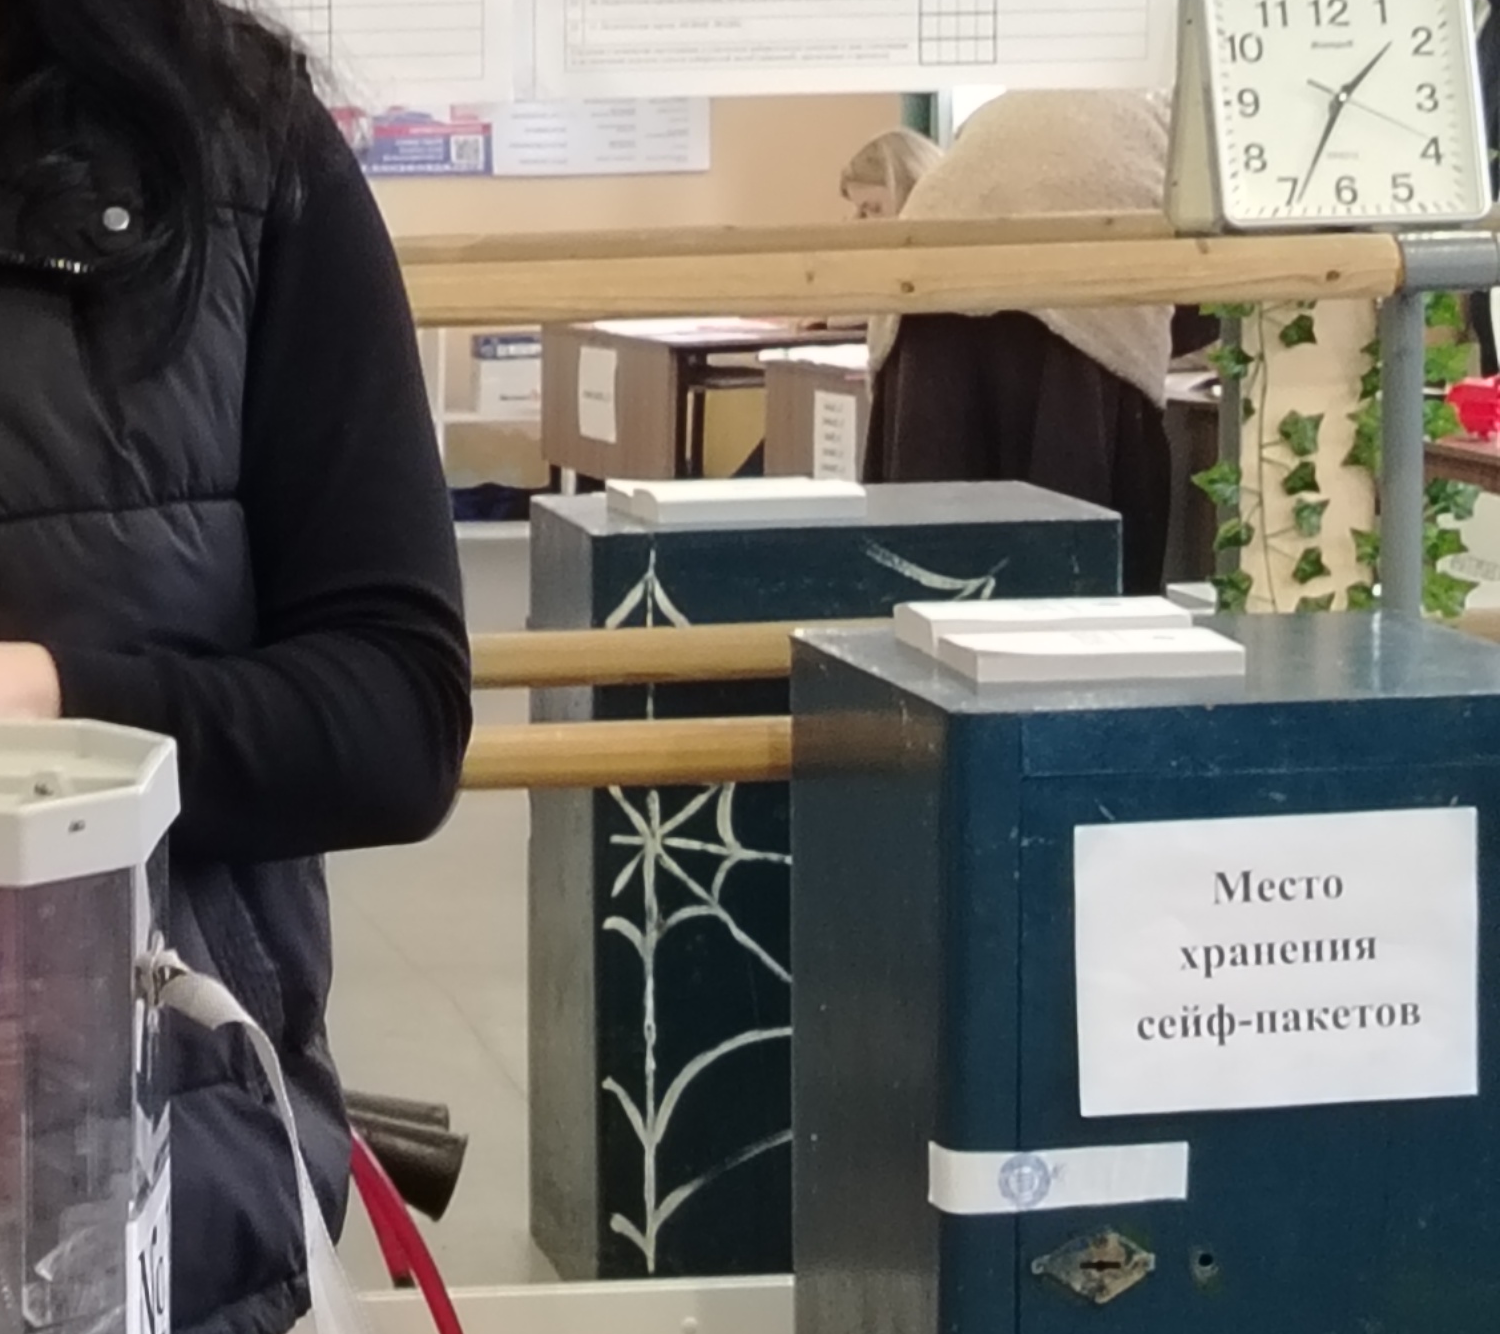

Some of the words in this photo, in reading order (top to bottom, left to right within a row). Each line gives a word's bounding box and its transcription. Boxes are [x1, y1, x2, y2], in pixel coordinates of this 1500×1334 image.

[1259, 0, 1288, 28] 11
[1228, 32, 1263, 63] 10
[1411, 27, 1434, 57] 2
[1237, 88, 1260, 117] 9
[1416, 83, 1439, 113] 3
[1244, 144, 1267, 173] 8
[1421, 137, 1443, 166] 4
[1277, 177, 1299, 206] 7
[1335, 176, 1358, 205] 6
[1391, 173, 1414, 203] 5
[1213, 870, 1345, 906] Место
[1179, 934, 1377, 978] хранения
[1136, 1000, 1422, 1046] сейф-пакетов
